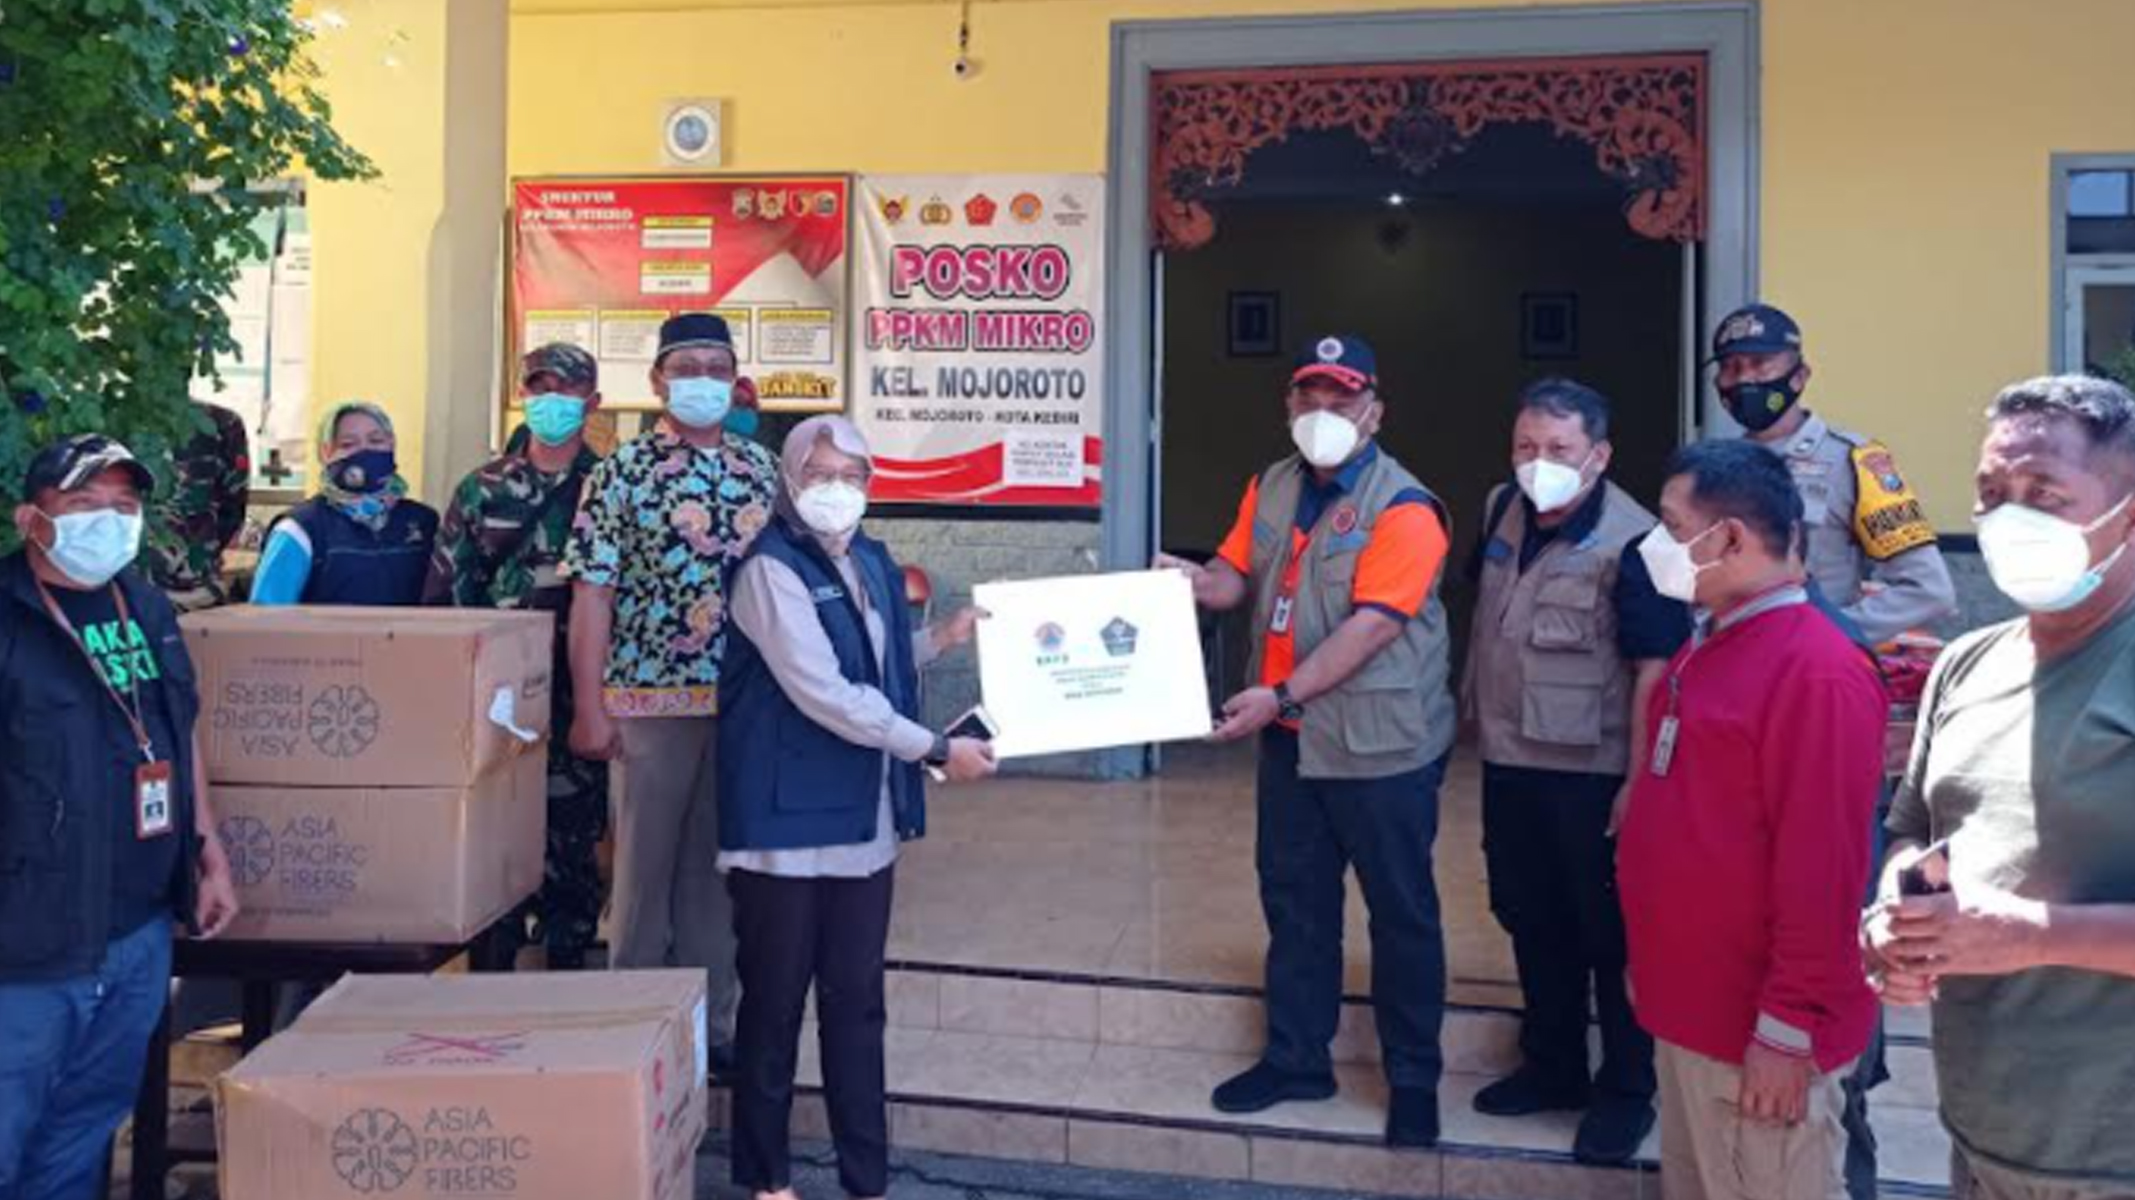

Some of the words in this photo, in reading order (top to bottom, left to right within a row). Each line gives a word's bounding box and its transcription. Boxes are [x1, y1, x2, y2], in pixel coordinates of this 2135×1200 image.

[891, 244, 1069, 300] POSKO
[865, 308, 968, 350] PPKM
[973, 310, 1094, 354] MIKRO
[870, 365, 928, 397] KEL.
[937, 367, 1086, 399] MOJOROTO
[910, 408, 984, 423] MOJOROTO
[995, 410, 1031, 424] KOTA
[226, 681, 304, 704] FIBERS
[213, 708, 302, 731] PACIFIC
[241, 735, 300, 757] ASIA
[281, 816, 339, 839] ASIA
[279, 842, 368, 868] PACIFIC
[280, 869, 357, 892] FIBERS
[424, 1106, 494, 1133] ASIA
[423, 1135, 533, 1162] PACIFIC
[425, 1165, 517, 1191] FIBERS
